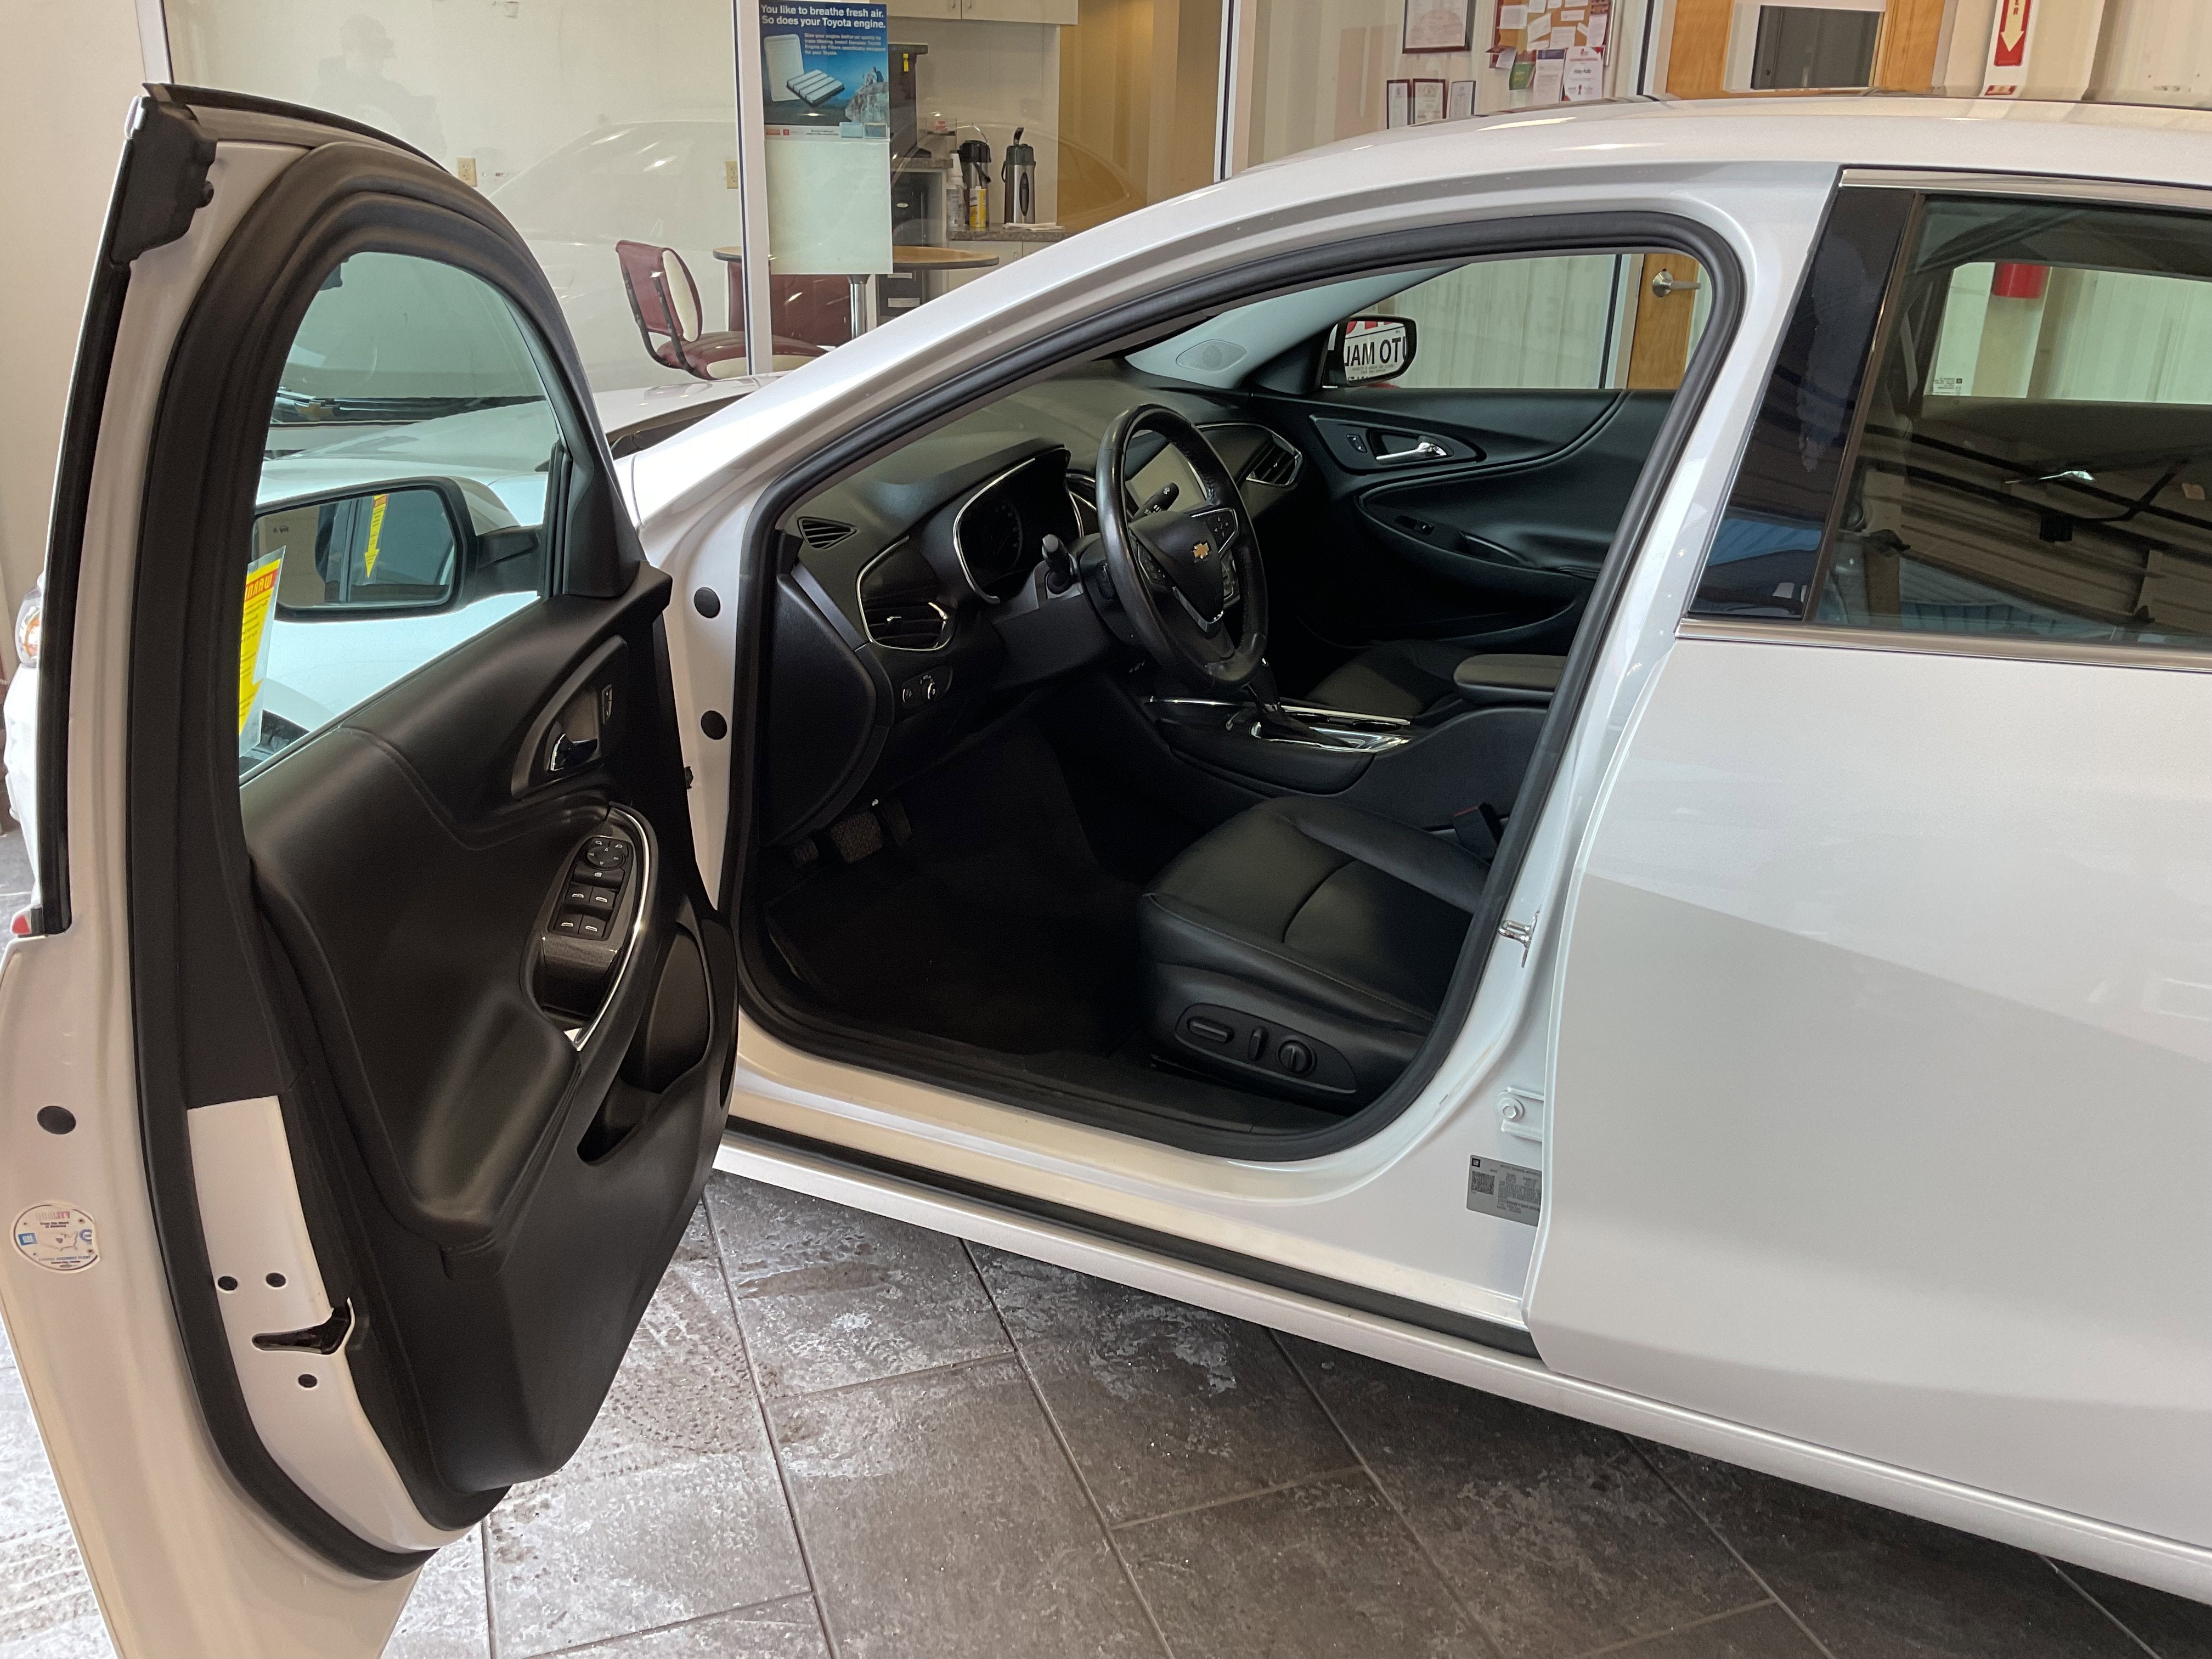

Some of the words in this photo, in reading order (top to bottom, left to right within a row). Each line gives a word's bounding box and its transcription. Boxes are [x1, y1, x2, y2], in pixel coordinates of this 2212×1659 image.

[761, 5, 777, 14] You
[780, 5, 796, 14] like
[810, 7, 844, 16] breathe
[846, 8, 868, 17] fresh
[871, 9, 884, 18] air.
[762, 16, 774, 24] So
[776, 16, 799, 25] does
[800, 18, 820, 27] your
[822, 18, 851, 28] Toyota
[854, 20, 886, 30] engine.
